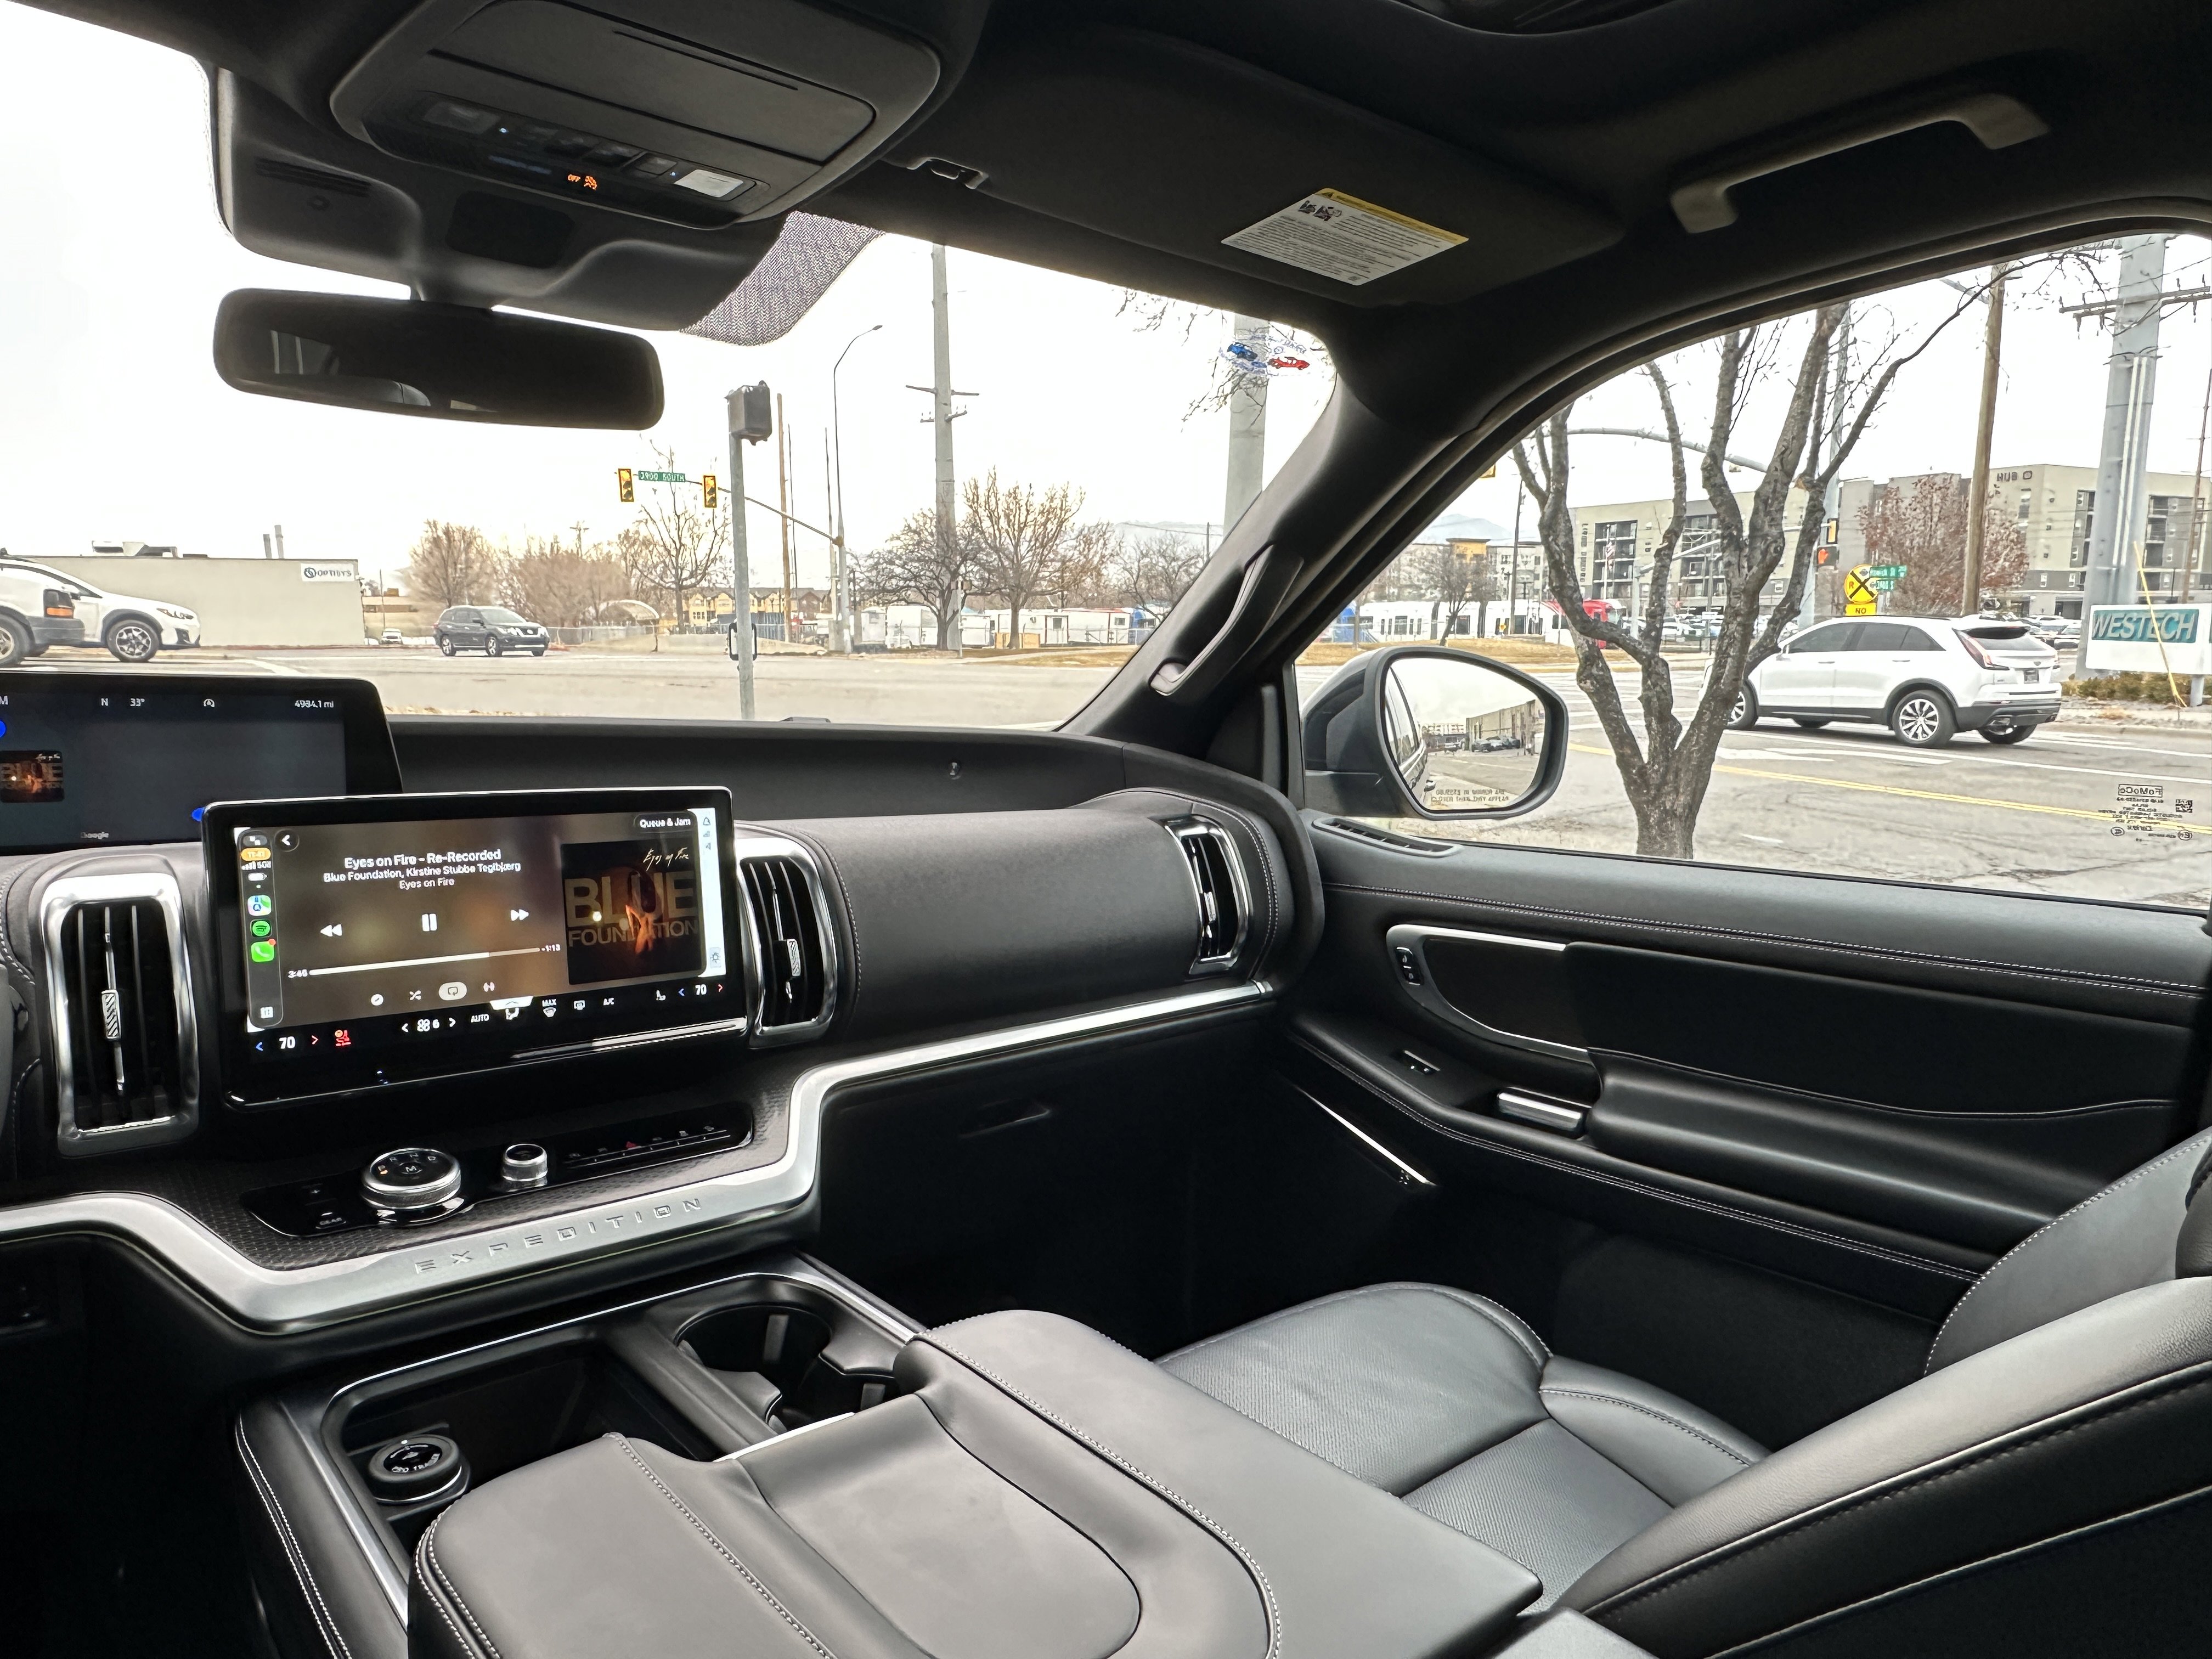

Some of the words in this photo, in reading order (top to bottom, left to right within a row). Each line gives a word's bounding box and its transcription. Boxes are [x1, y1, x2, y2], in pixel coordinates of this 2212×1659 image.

[2092, 612, 2196, 640] WESTECH
[101, 698, 109, 706] N
[345, 856, 375, 870] Eyes
[376, 857, 392, 866] on
[348, 868, 404, 881] Foundation,
[399, 879, 422, 890] Eyes
[695, 984, 707, 996] 70
[541, 998, 557, 1007] MAX
[432, 1019, 439, 1029] 6
[470, 1014, 489, 1023] AUTO
[279, 1036, 296, 1049] 70
[414, 1198, 702, 1275] EXPEDITION
